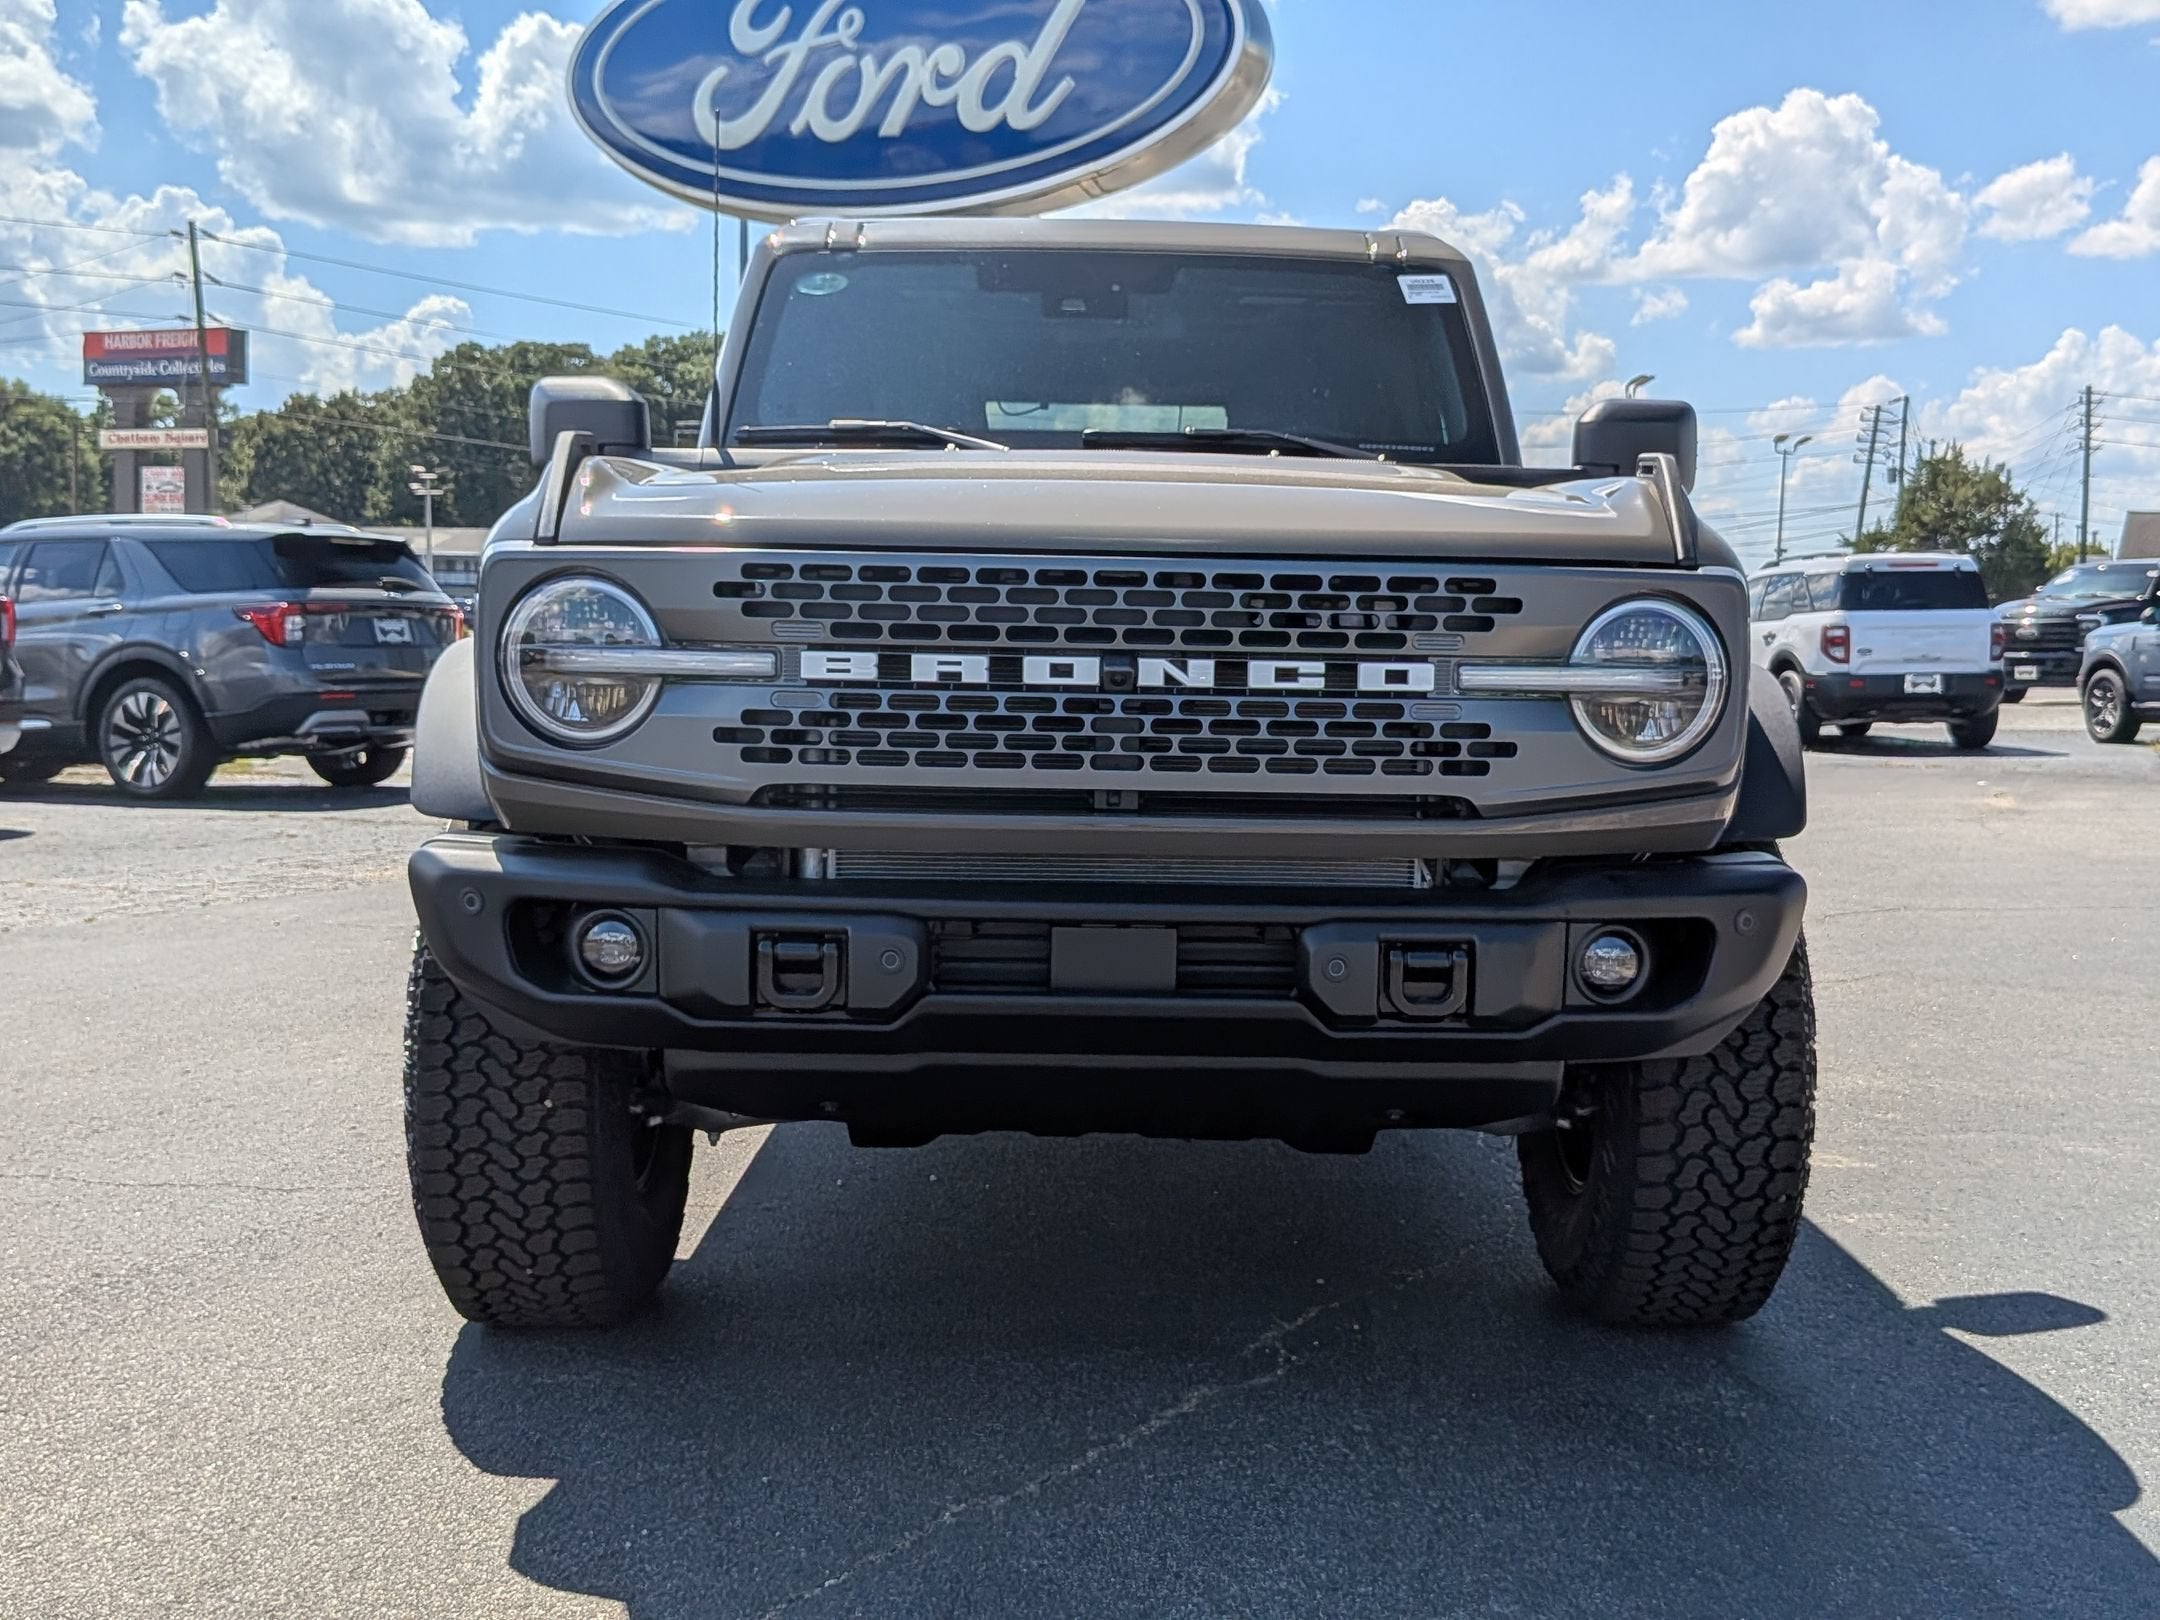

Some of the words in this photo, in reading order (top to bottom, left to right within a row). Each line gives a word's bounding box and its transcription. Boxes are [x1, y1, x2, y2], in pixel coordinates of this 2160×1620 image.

[693, 0, 1080, 151] Ford
[104, 333, 153, 350] HARBOR
[154, 330, 203, 348] FREIGH
[89, 360, 158, 380] Countryside
[165, 431, 208, 446] Square
[800, 650, 1434, 692] BRONCO
